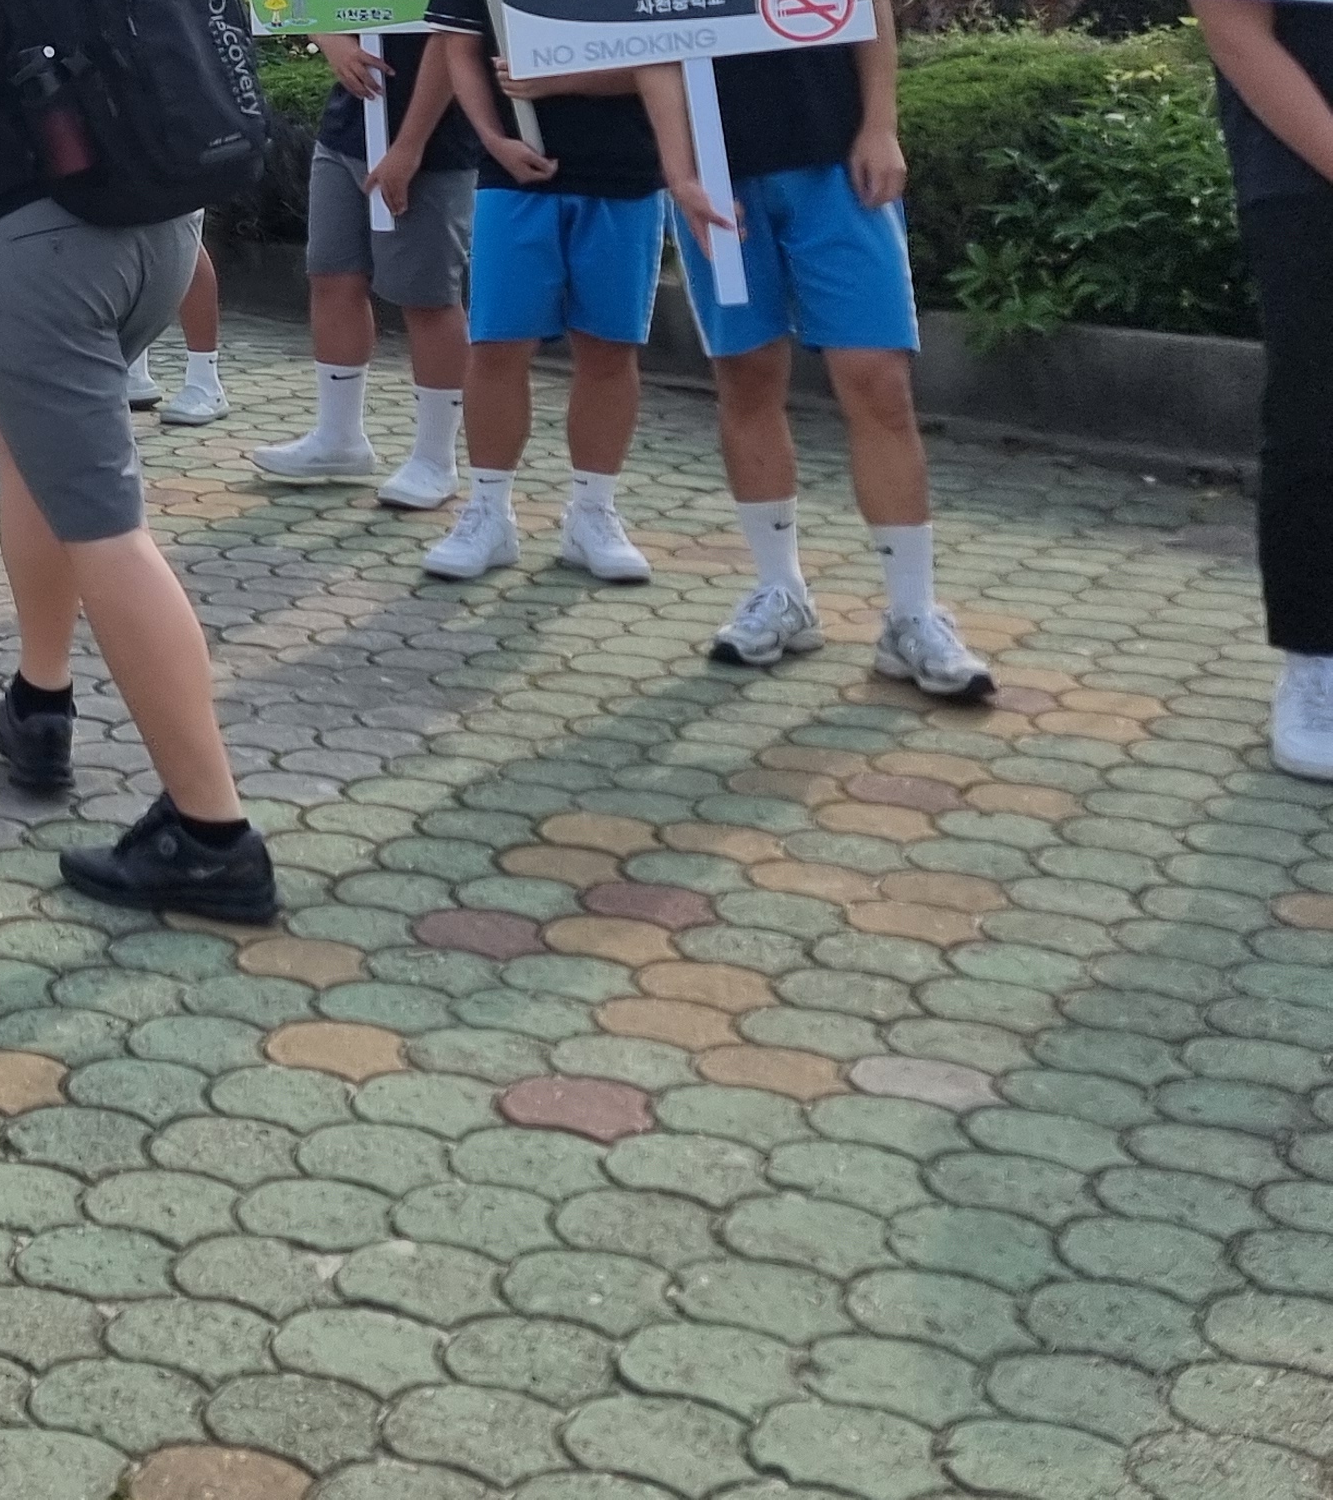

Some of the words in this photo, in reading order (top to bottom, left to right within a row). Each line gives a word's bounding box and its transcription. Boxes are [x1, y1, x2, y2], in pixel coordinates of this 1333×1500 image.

[335, 8, 394, 22] 사천중학교
[532, 45, 574, 68] NO
[584, 28, 718, 62] SMOKING
